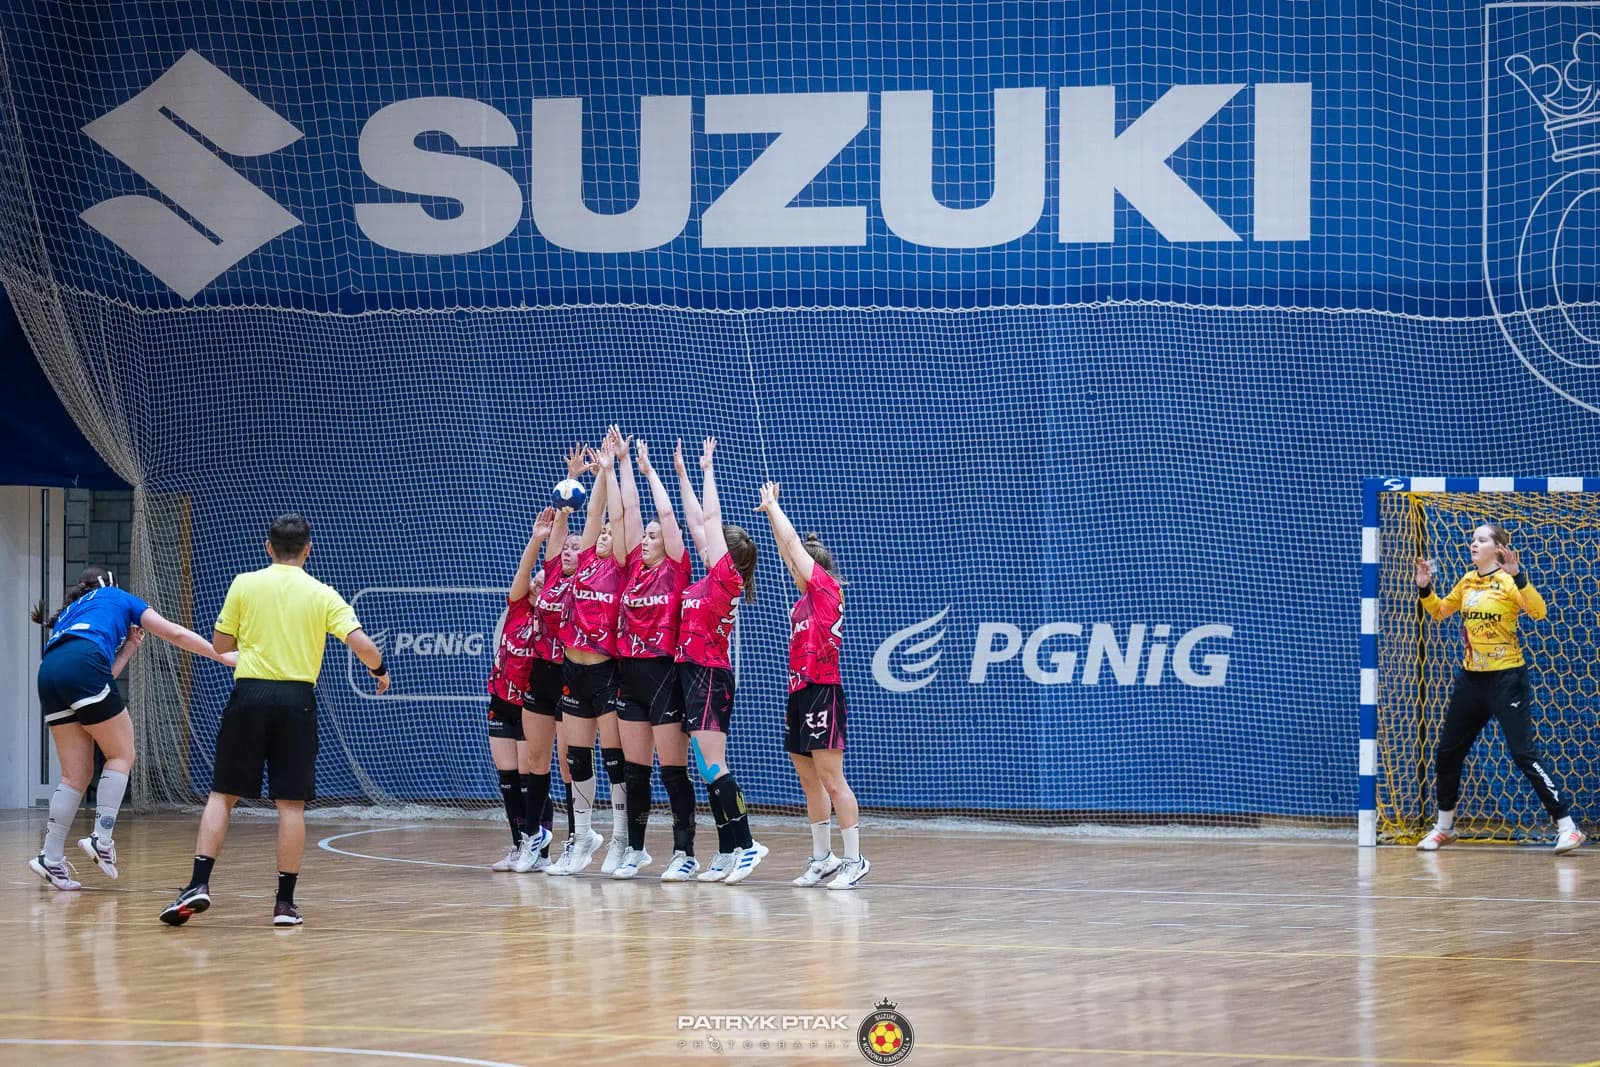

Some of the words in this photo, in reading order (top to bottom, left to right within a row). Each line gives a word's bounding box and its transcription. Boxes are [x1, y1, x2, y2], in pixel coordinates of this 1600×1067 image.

[356, 82, 1312, 255] SUZUKI
[1462, 611, 1502, 622] SUZUKI
[394, 632, 484, 656] PGNiG
[968, 621, 1234, 687] PGNiG
